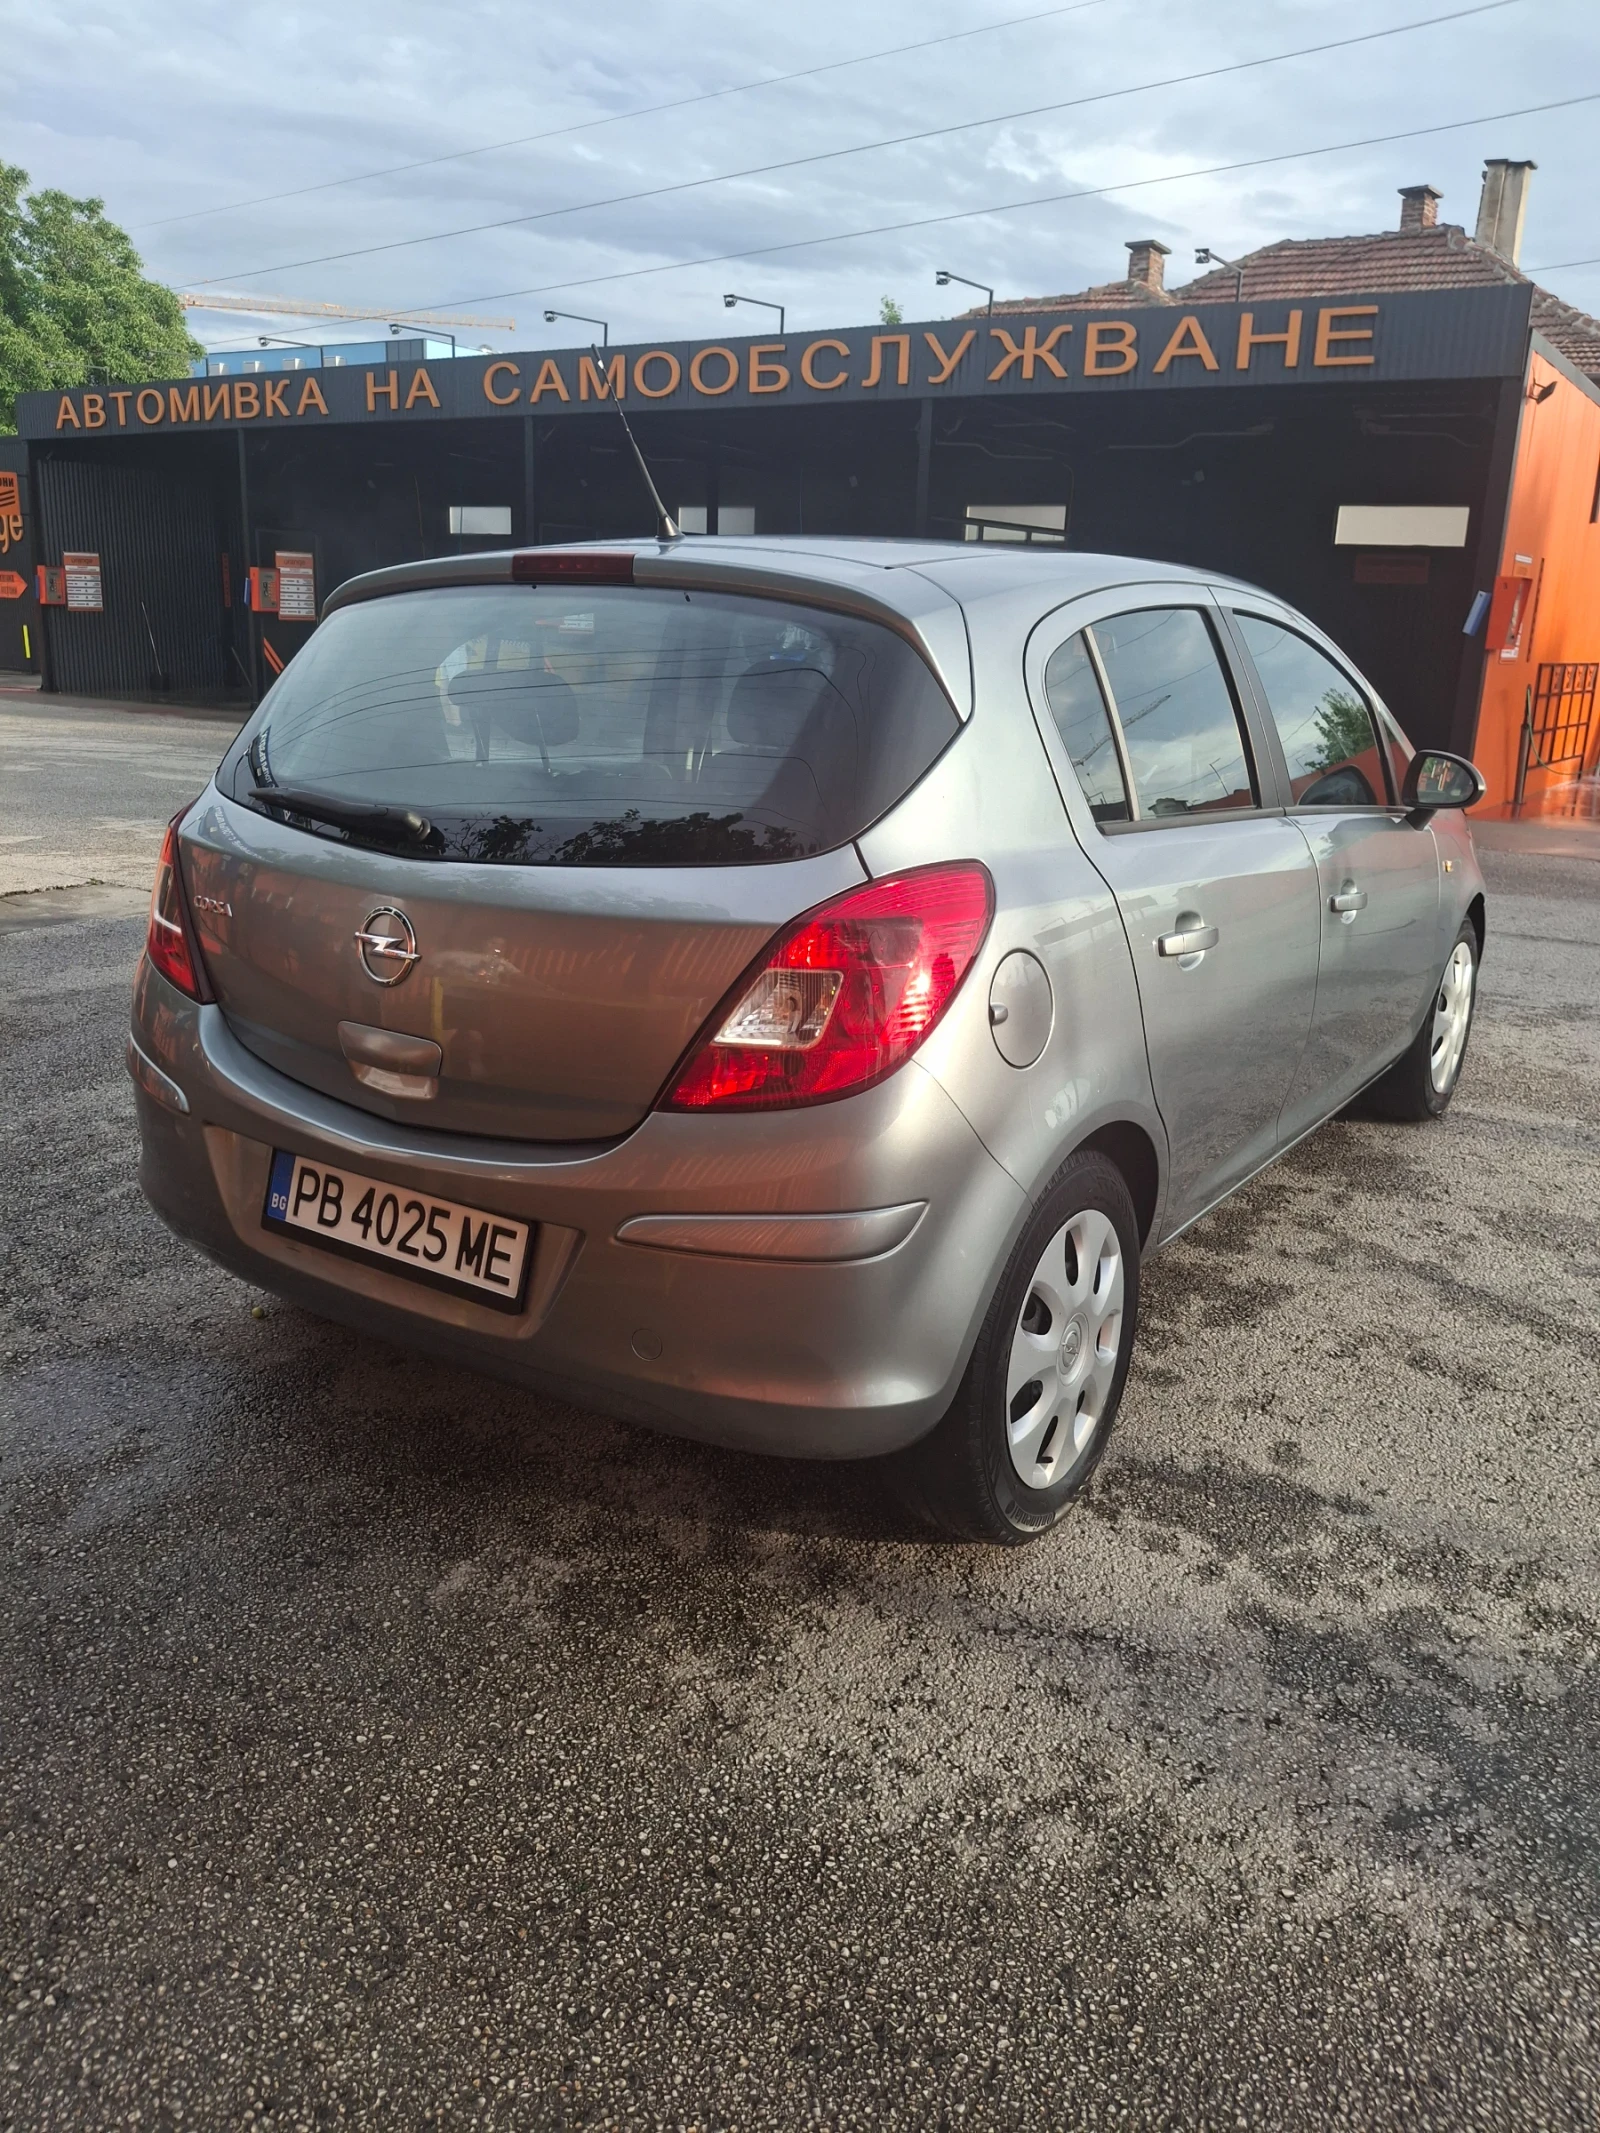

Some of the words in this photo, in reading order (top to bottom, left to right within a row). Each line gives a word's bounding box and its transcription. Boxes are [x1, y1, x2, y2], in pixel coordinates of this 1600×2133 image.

[56, 377, 329, 430] АВТОМИВКА
[365, 367, 442, 412] НА
[483, 304, 1379, 405] САМООБСЛУЖВАНЕ
[194, 895, 232, 917] CORSA
[271, 1193, 287, 1210] BG
[292, 1166, 344, 1228] PB
[351, 1187, 451, 1262] 4025
[455, 1216, 517, 1287] ME
